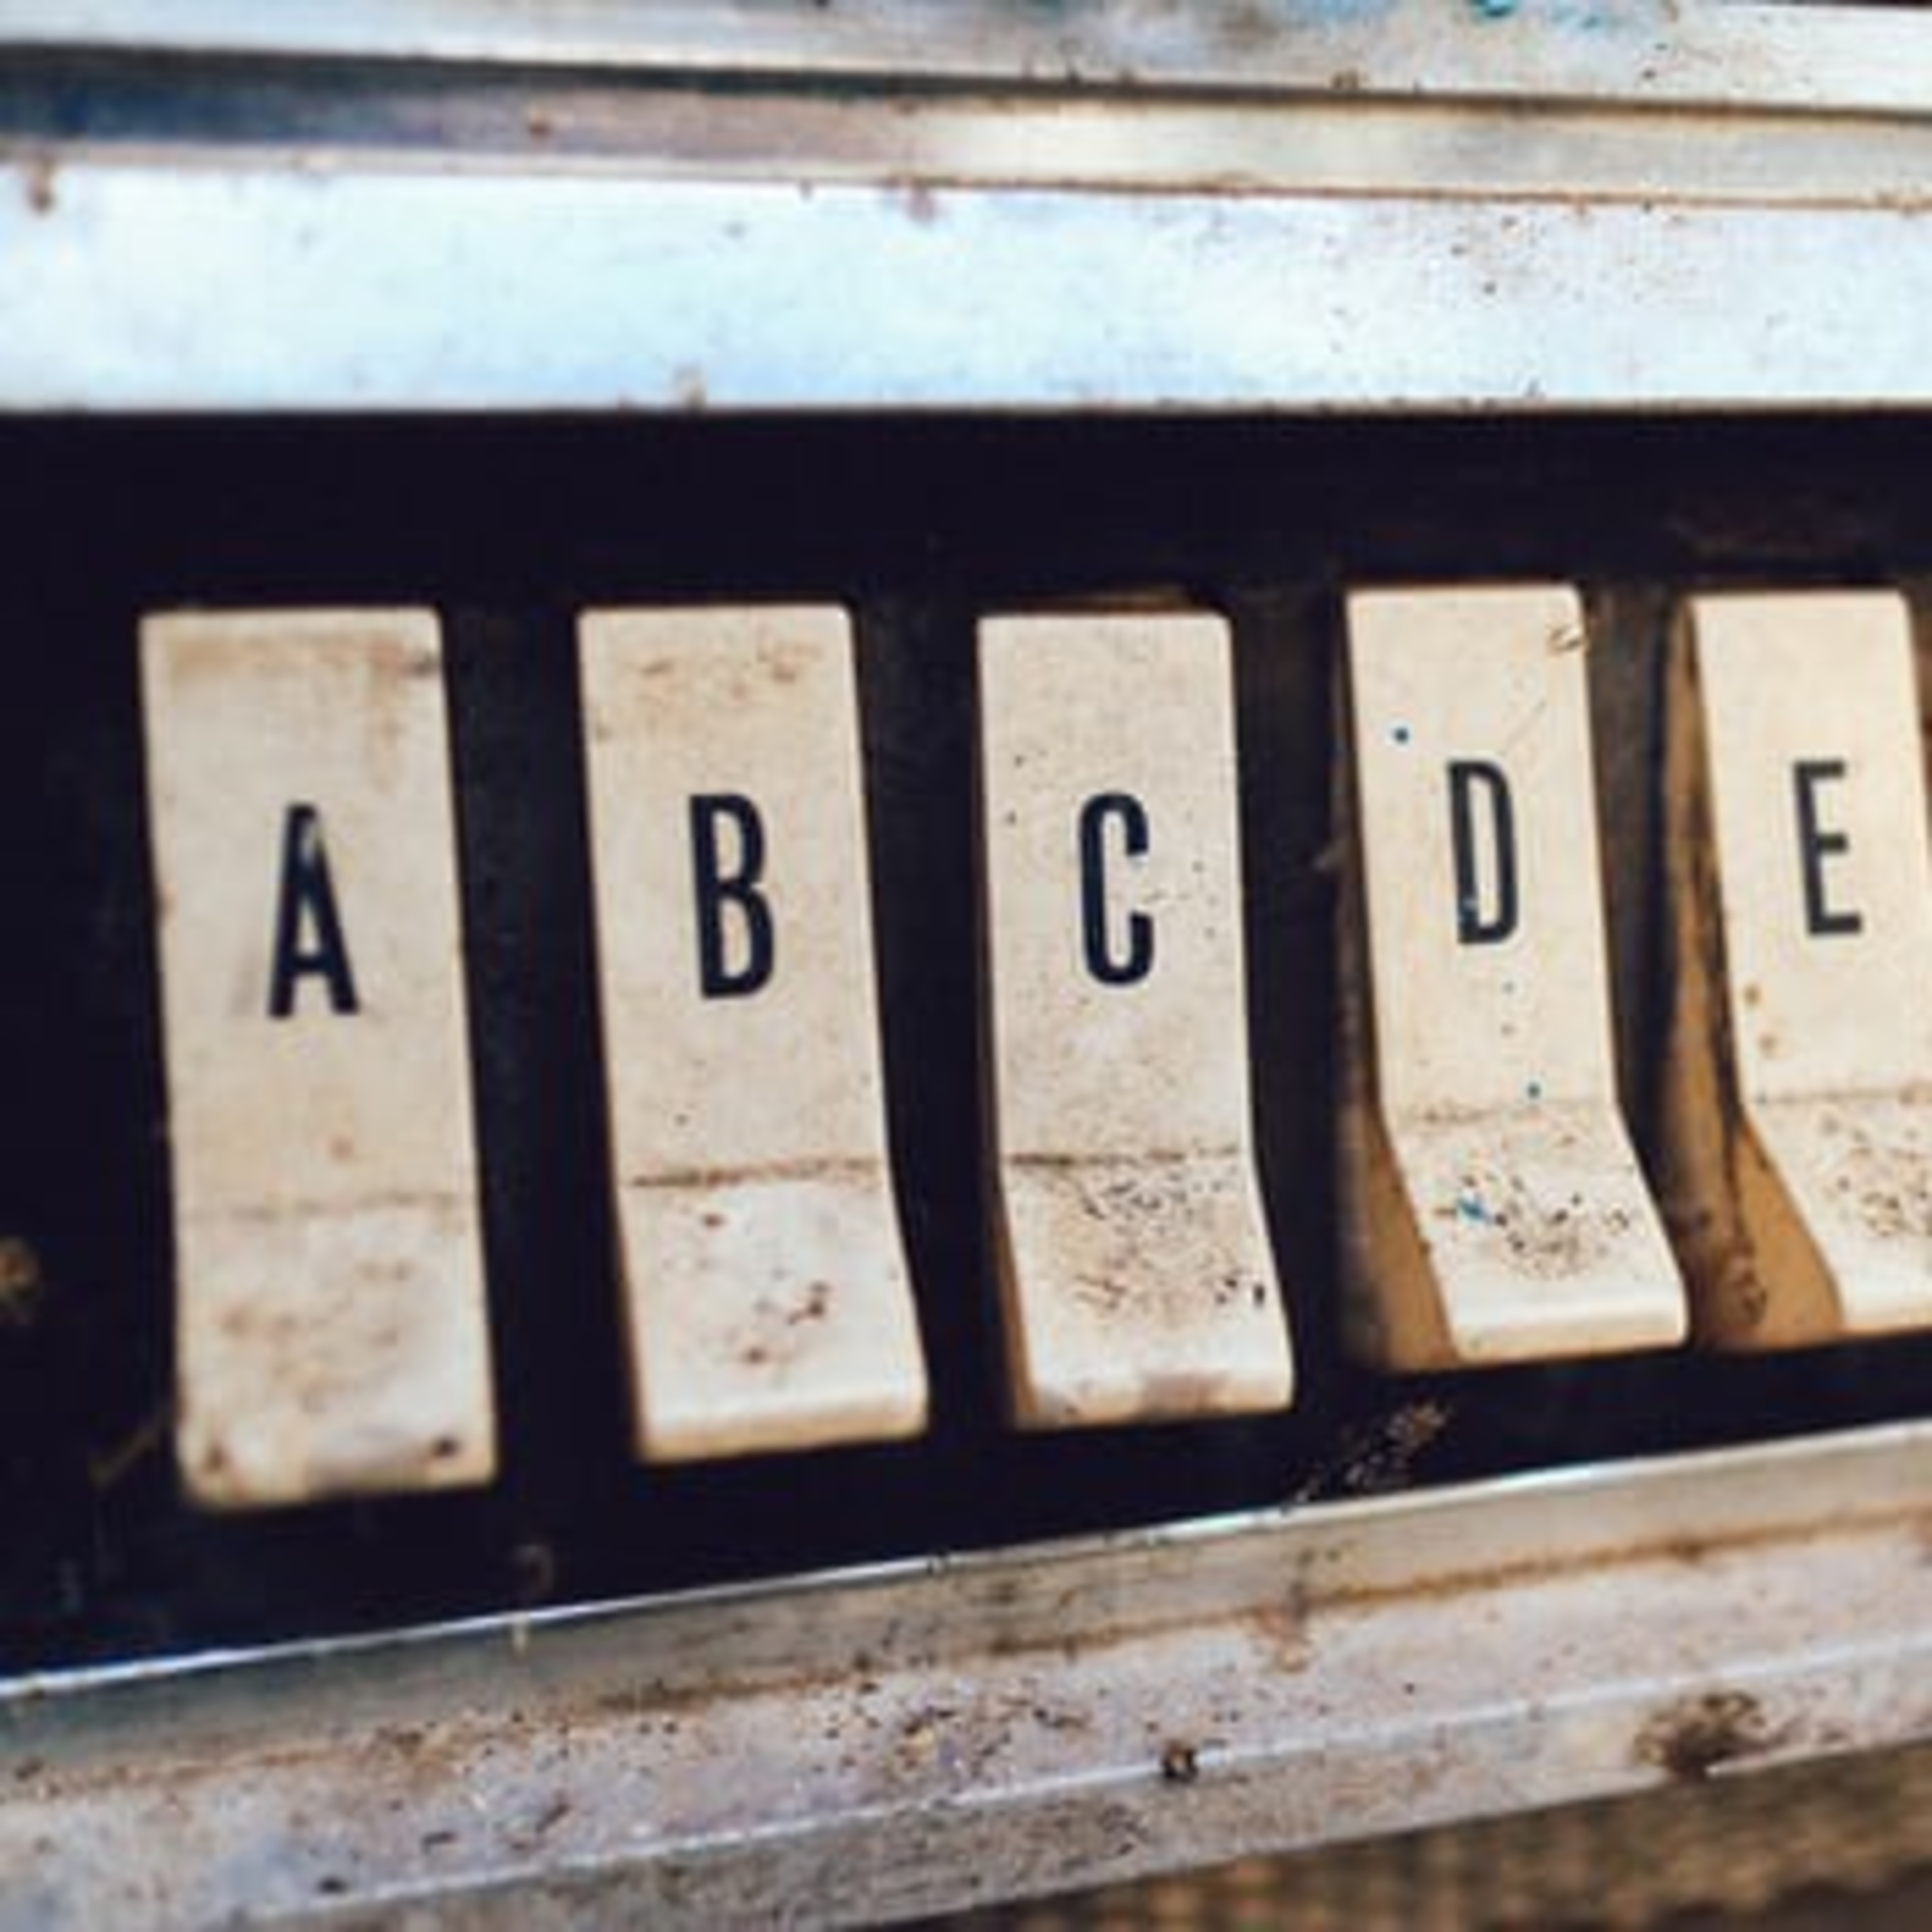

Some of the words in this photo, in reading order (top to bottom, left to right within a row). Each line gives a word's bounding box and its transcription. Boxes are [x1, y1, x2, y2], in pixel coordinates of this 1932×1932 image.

[268, 802, 361, 1020] A
[688, 793, 775, 1000] B
[1078, 792, 1155, 987] C
[1447, 760, 1518, 945] D
[1794, 761, 1862, 936] E
